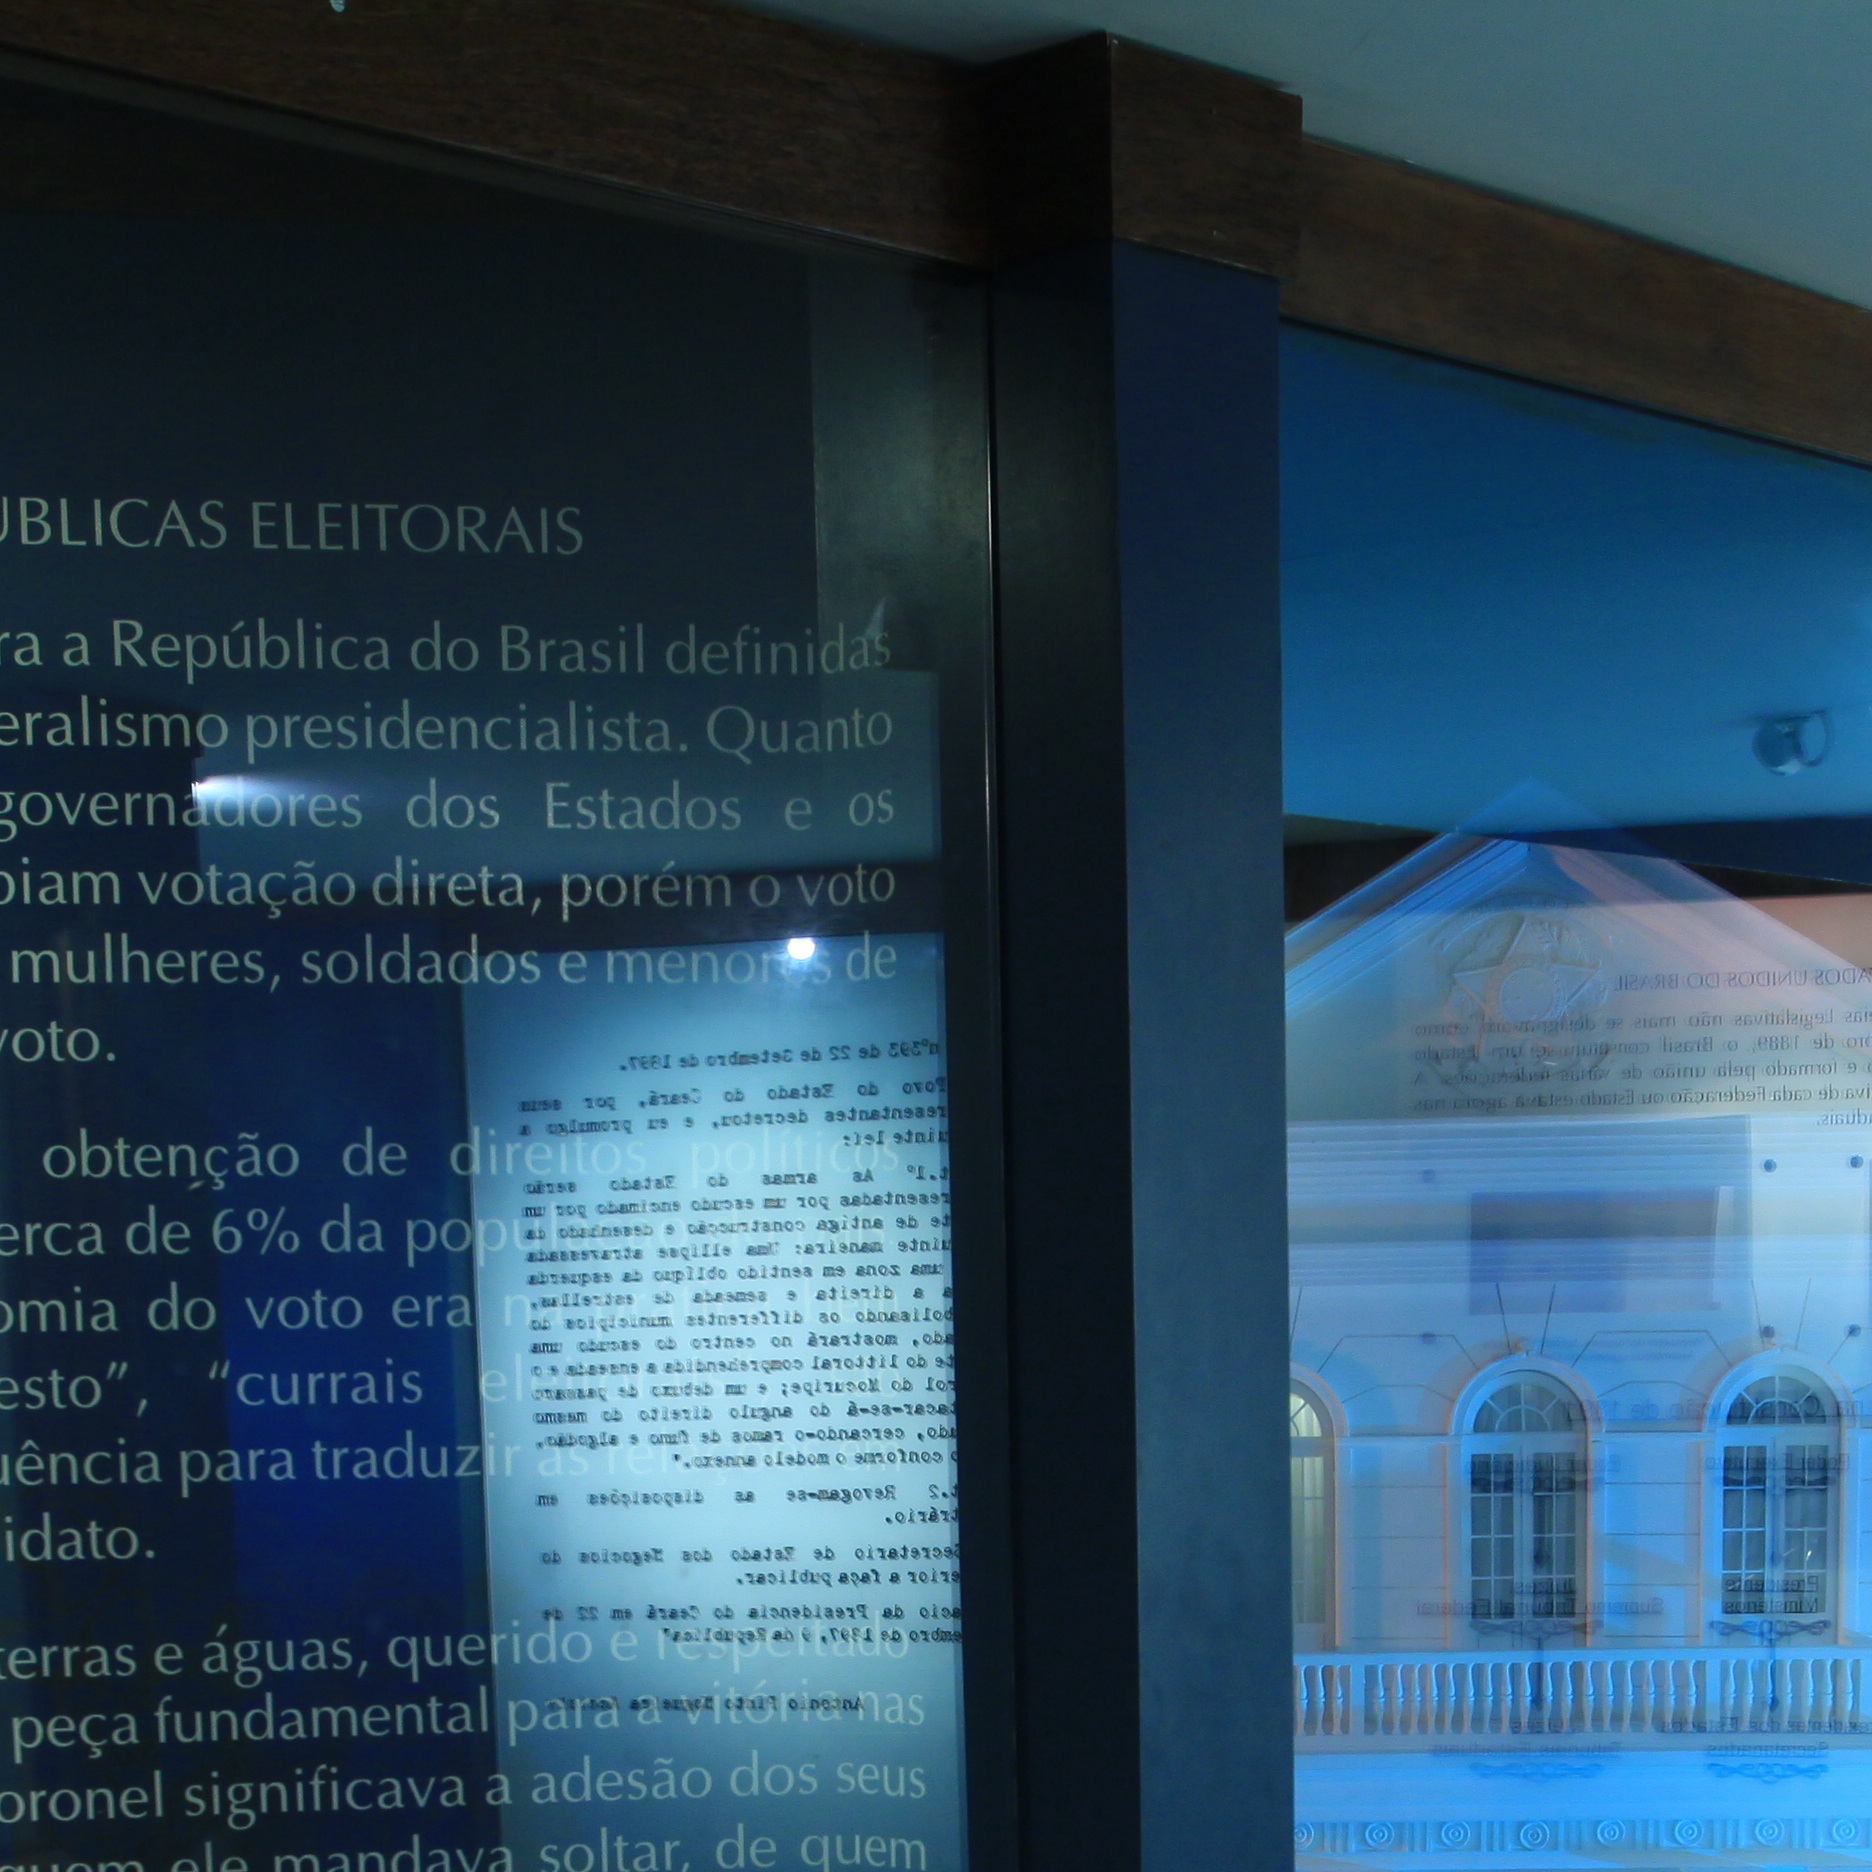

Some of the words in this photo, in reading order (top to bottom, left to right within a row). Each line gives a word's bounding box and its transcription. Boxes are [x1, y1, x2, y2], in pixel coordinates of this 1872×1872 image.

[250, 500, 584, 556] ELEITORAIS
[245, 697, 689, 766] presidencialista.
[705, 704, 894, 766] Quanto
[136, 859, 357, 920] votação
[371, 854, 543, 916] direta,
[560, 859, 732, 924] porém
[748, 875, 782, 908] o
[796, 863, 897, 908] voto
